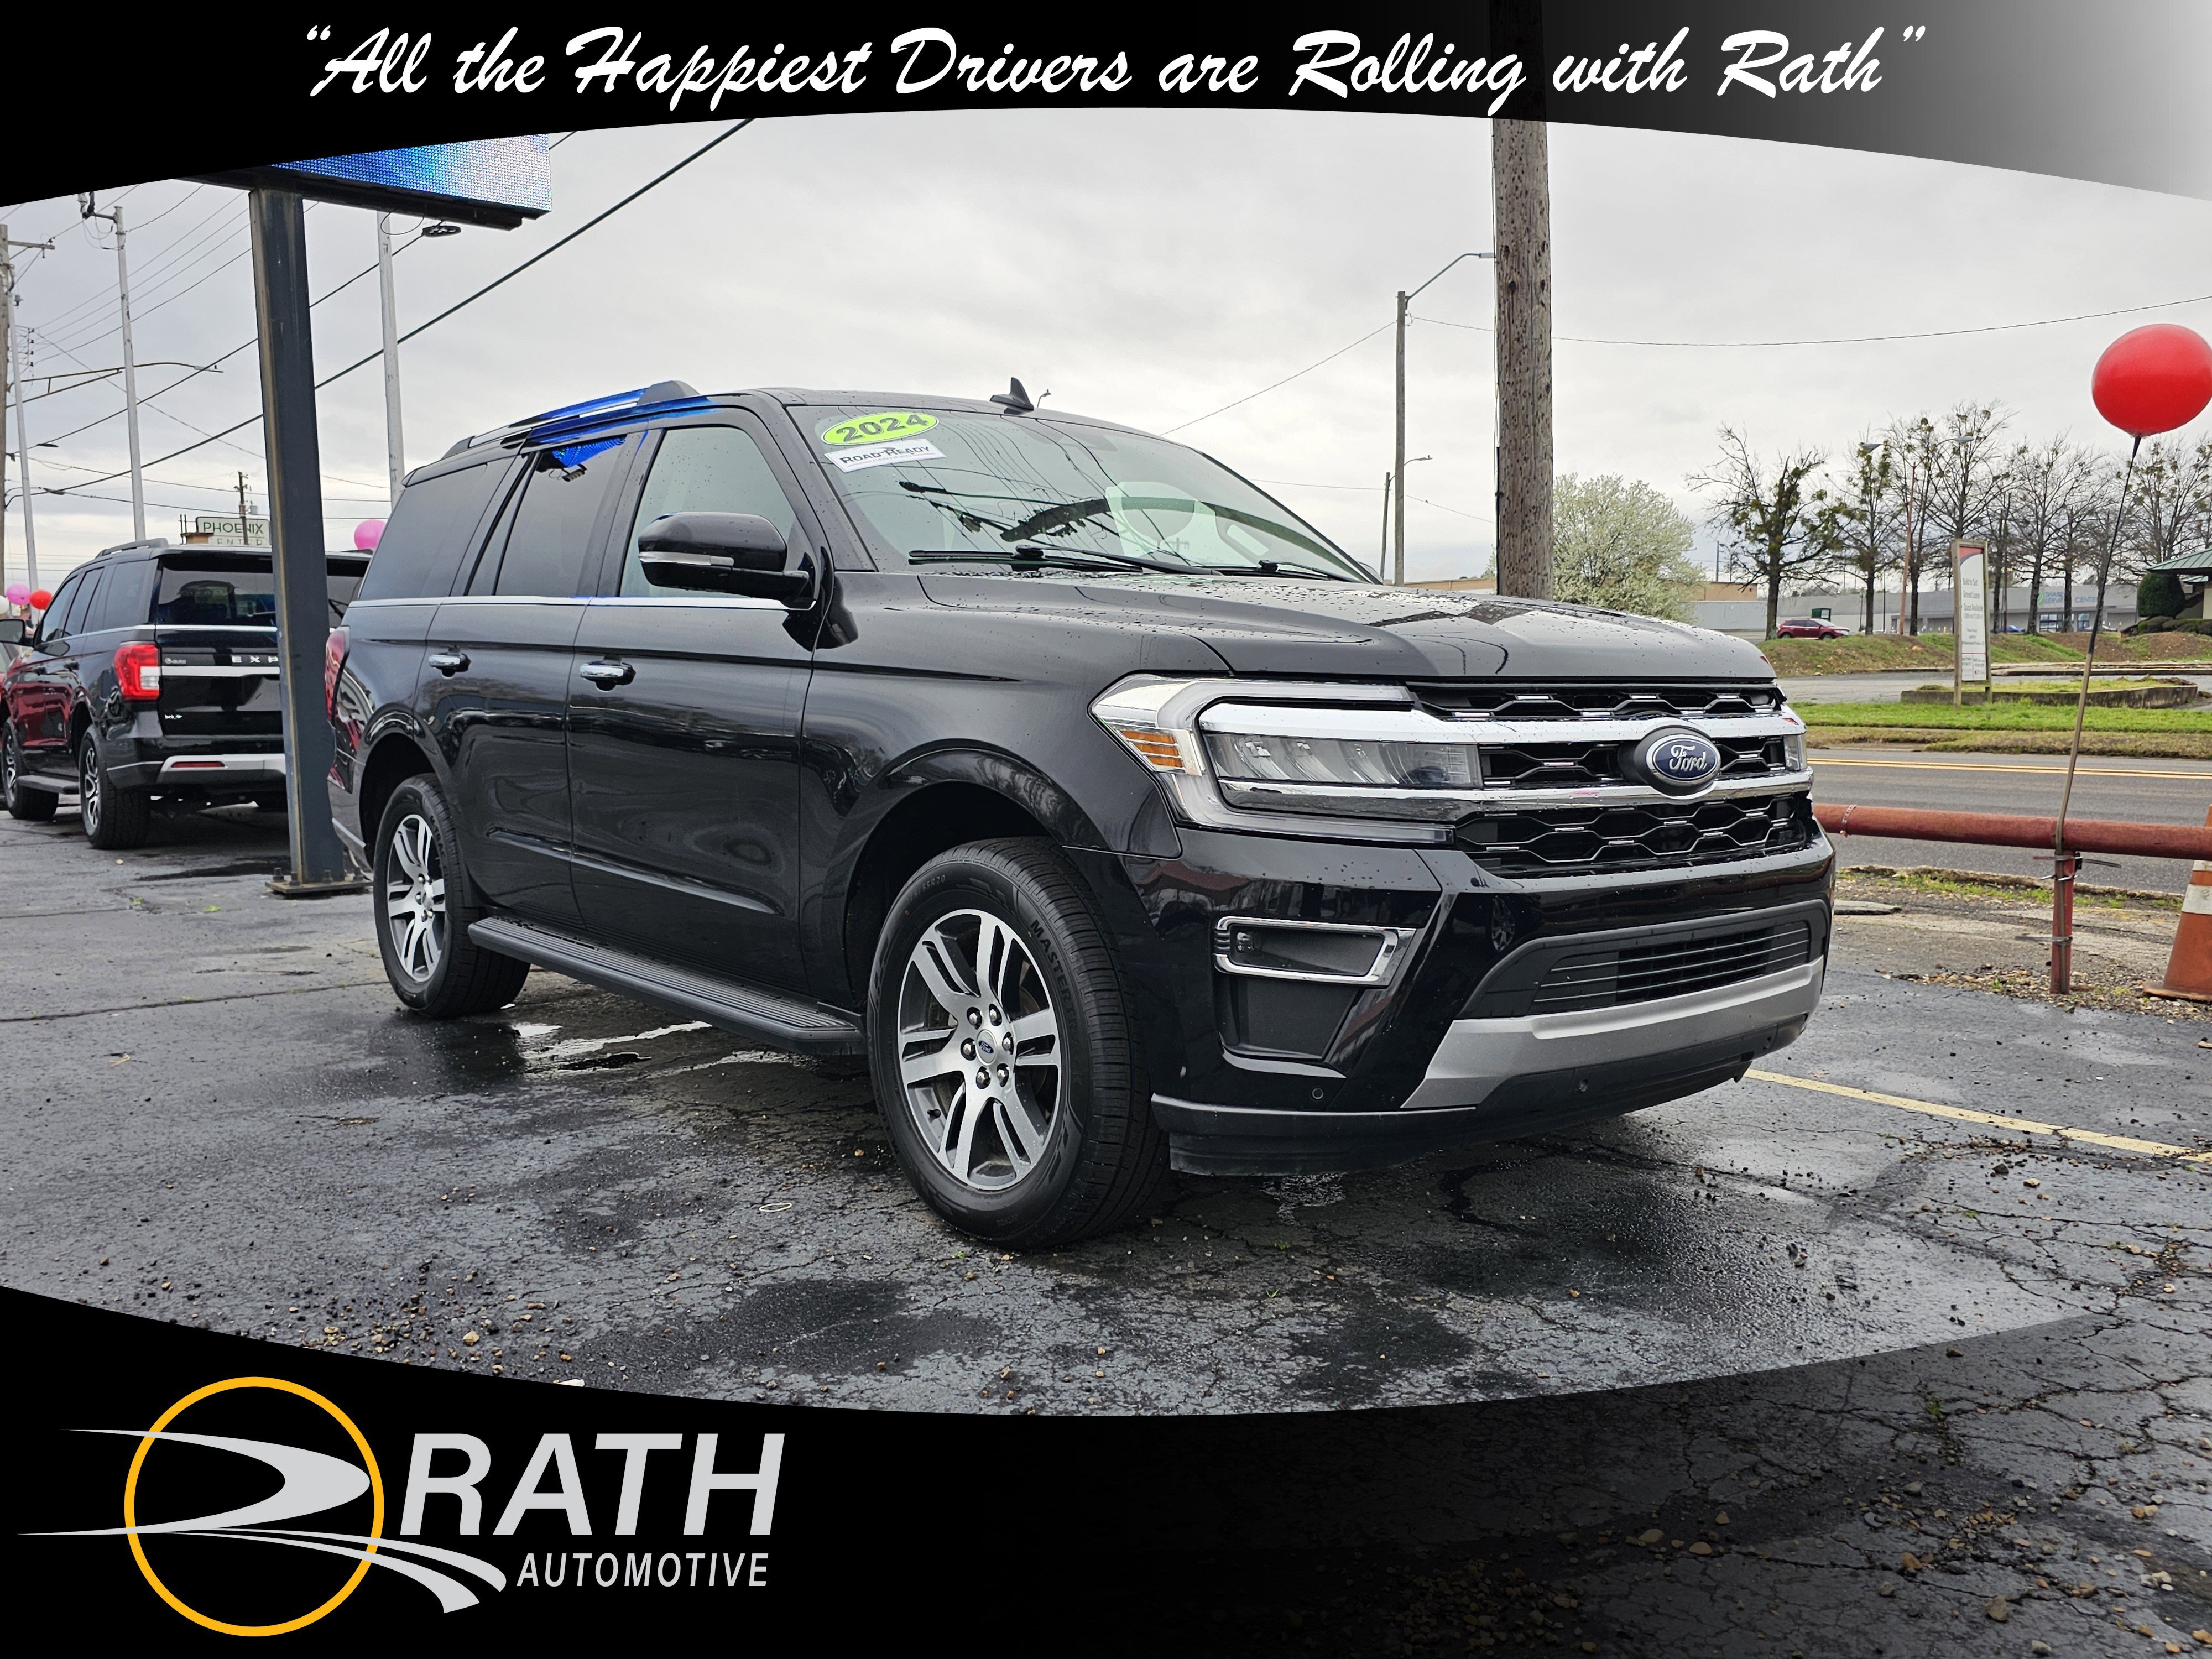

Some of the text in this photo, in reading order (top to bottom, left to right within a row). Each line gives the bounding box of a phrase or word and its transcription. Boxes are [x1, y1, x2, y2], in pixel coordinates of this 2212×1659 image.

[836, 414, 929, 442] 2024
[840, 451, 881, 464] ROAD
[203, 521, 264, 534] PHOENIX
[1669, 744, 1707, 772] Ford
